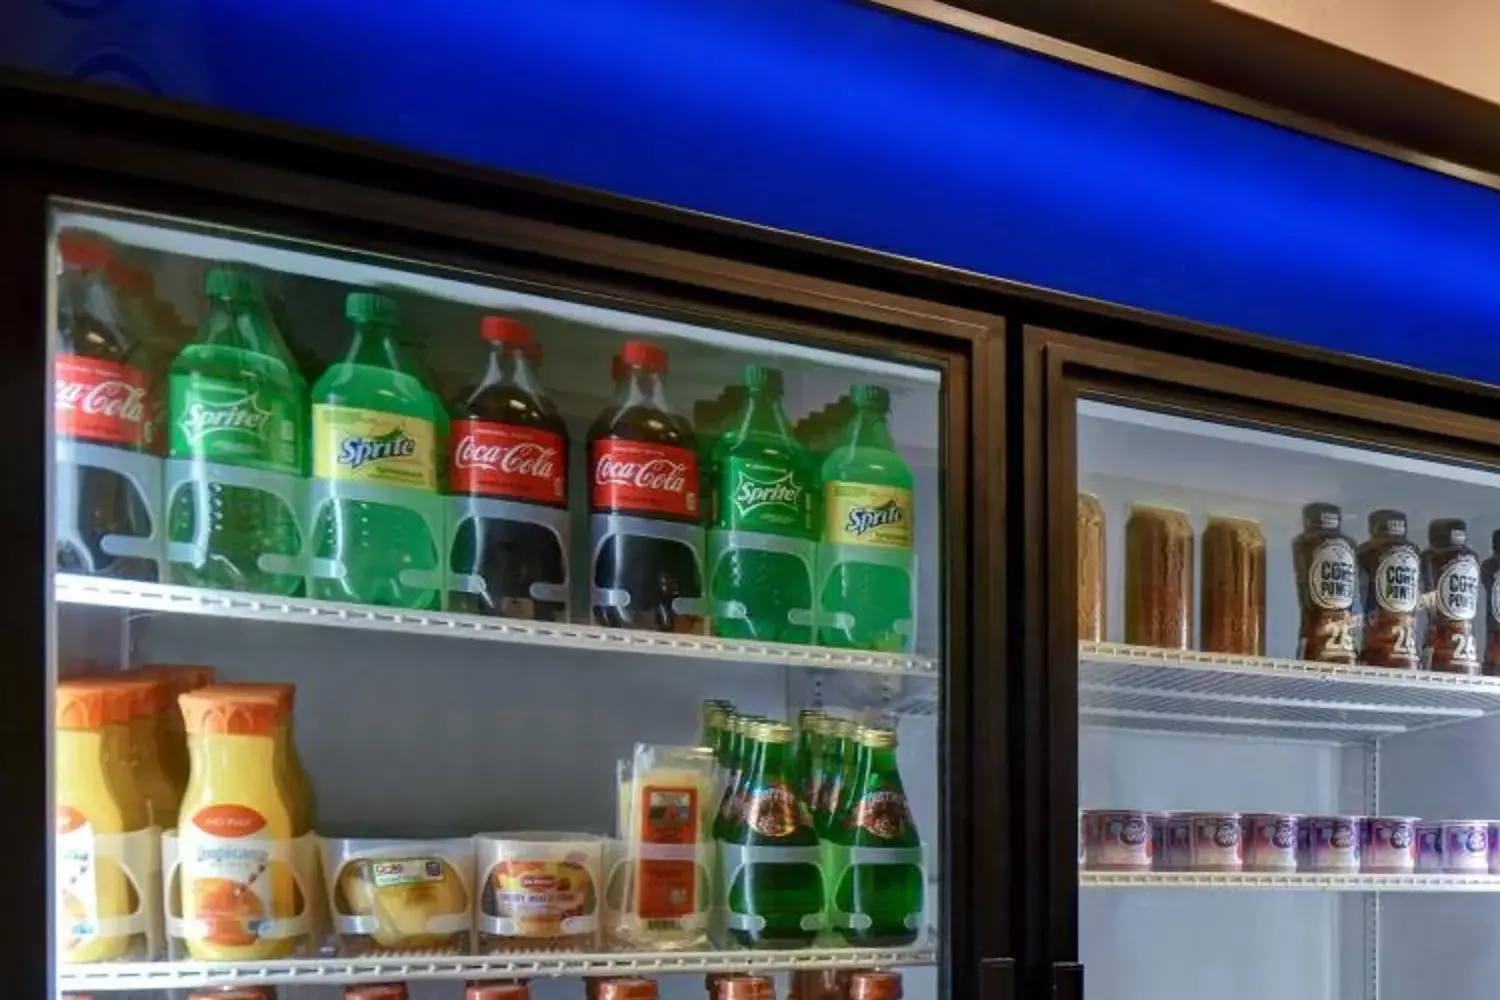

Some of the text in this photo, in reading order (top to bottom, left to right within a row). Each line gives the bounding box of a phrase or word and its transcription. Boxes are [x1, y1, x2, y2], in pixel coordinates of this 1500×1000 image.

[188, 402, 262, 431] Sprite
[337, 435, 416, 470] Sprite
[455, 435, 555, 478] Coca-Cola
[596, 454, 686, 492] Coca-Cola
[739, 482, 797, 504] Sprite
